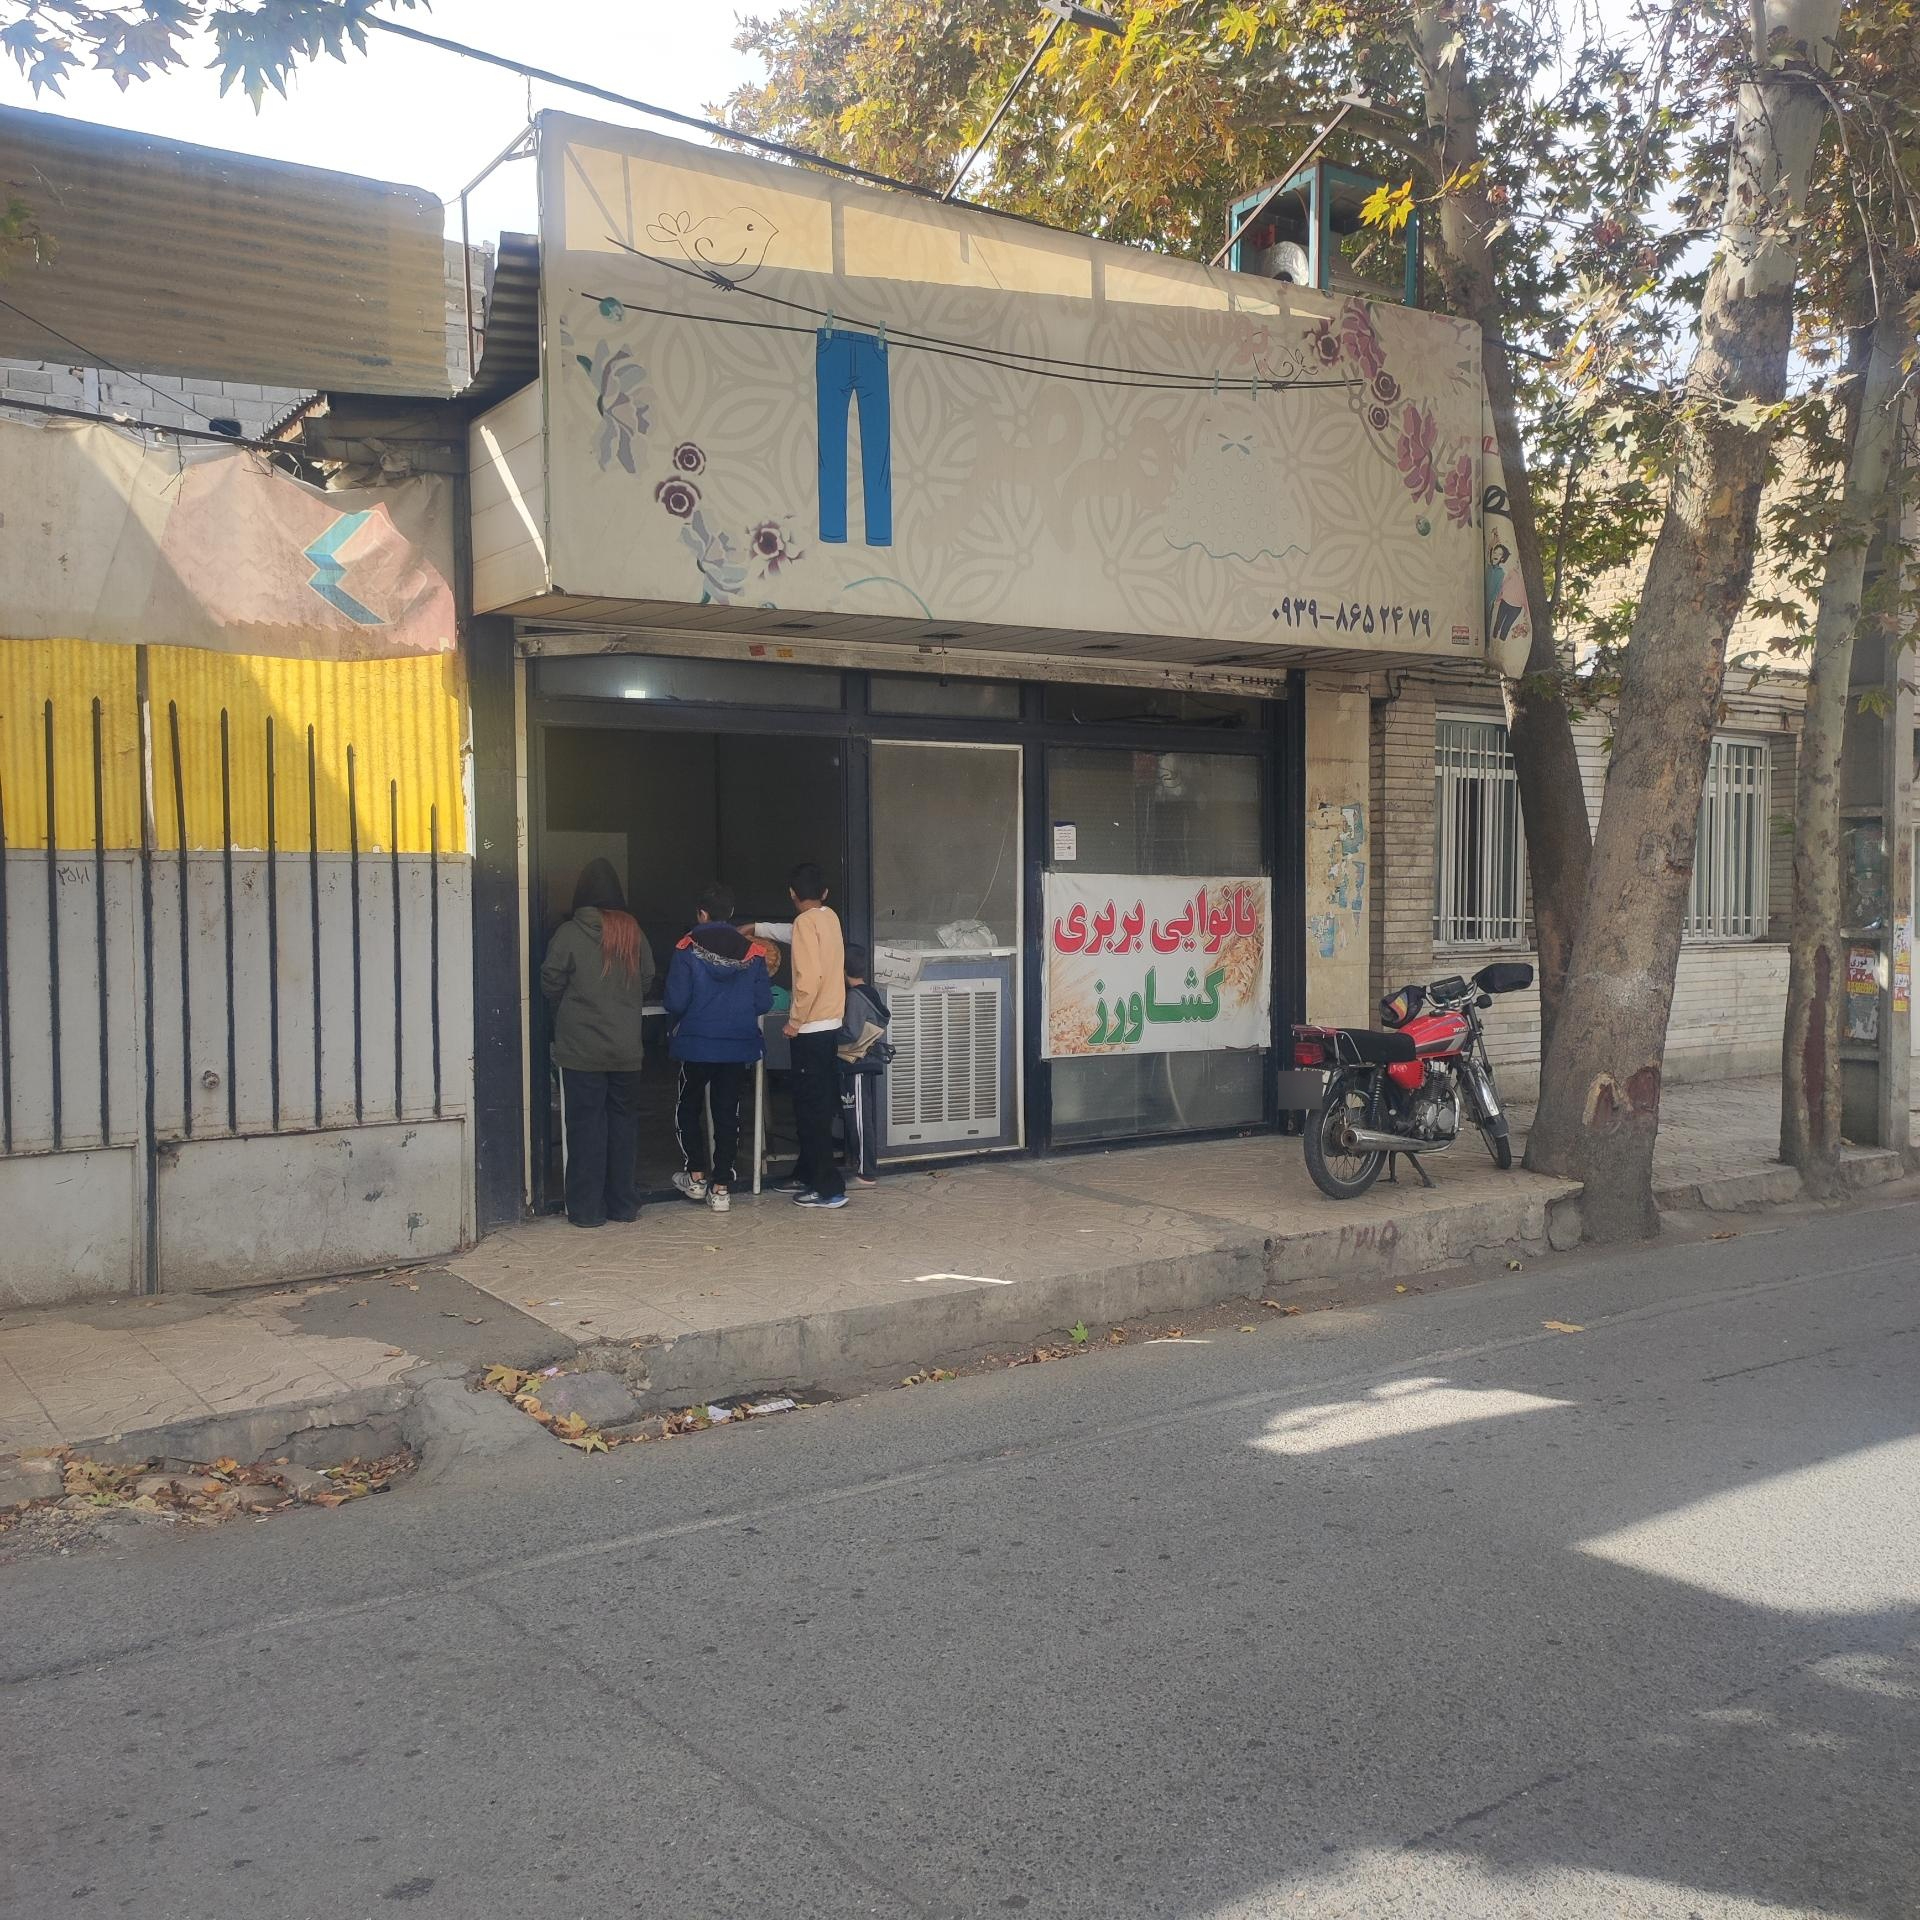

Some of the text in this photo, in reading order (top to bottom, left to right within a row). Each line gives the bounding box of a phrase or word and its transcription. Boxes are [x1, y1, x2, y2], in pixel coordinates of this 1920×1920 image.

[1054, 885, 1257, 955] نانوایی بربری
[1087, 966, 1225, 1046] کشاورز
